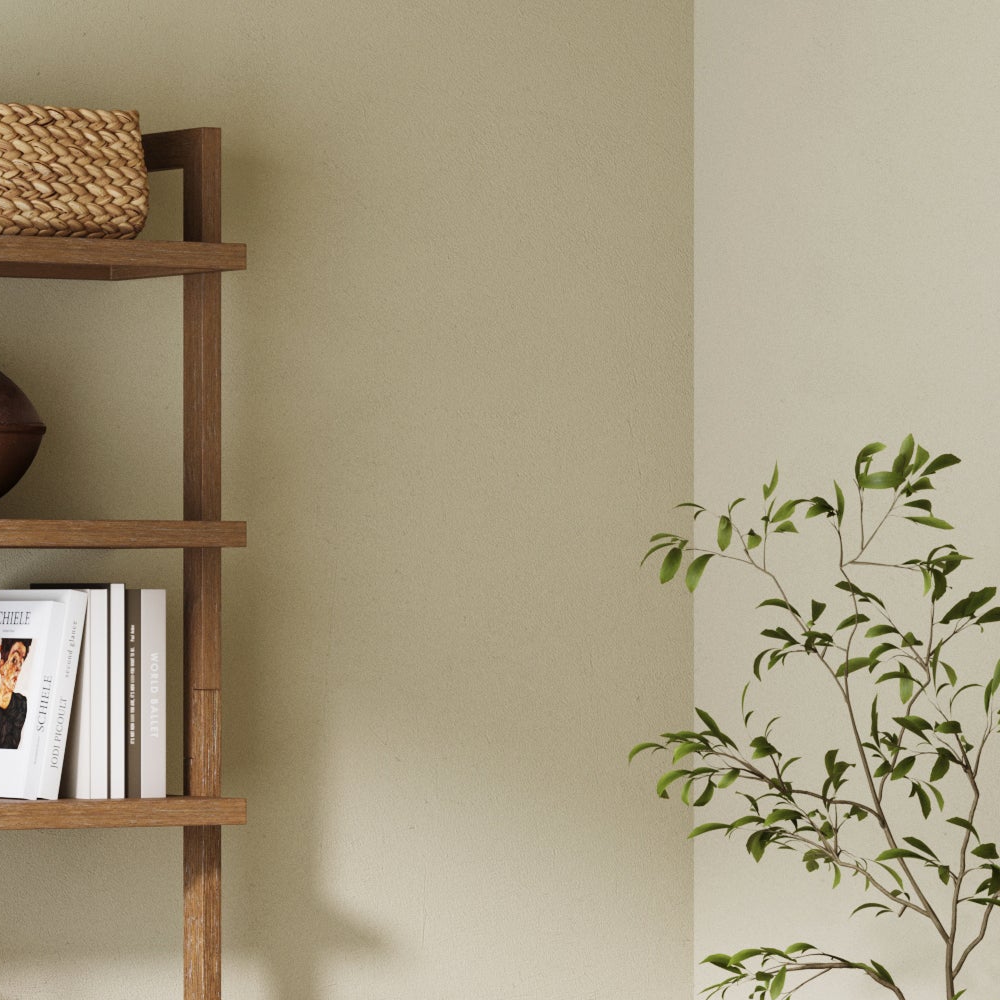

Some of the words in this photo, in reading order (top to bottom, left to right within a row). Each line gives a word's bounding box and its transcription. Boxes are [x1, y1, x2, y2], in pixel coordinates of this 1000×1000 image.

[150, 652, 159, 694] WORLD
[36, 675, 53, 733] SCHIELE
[54, 698, 68, 742] PICOULT
[150, 698, 159, 738] BALLET
[50, 745, 61, 769] JODI
